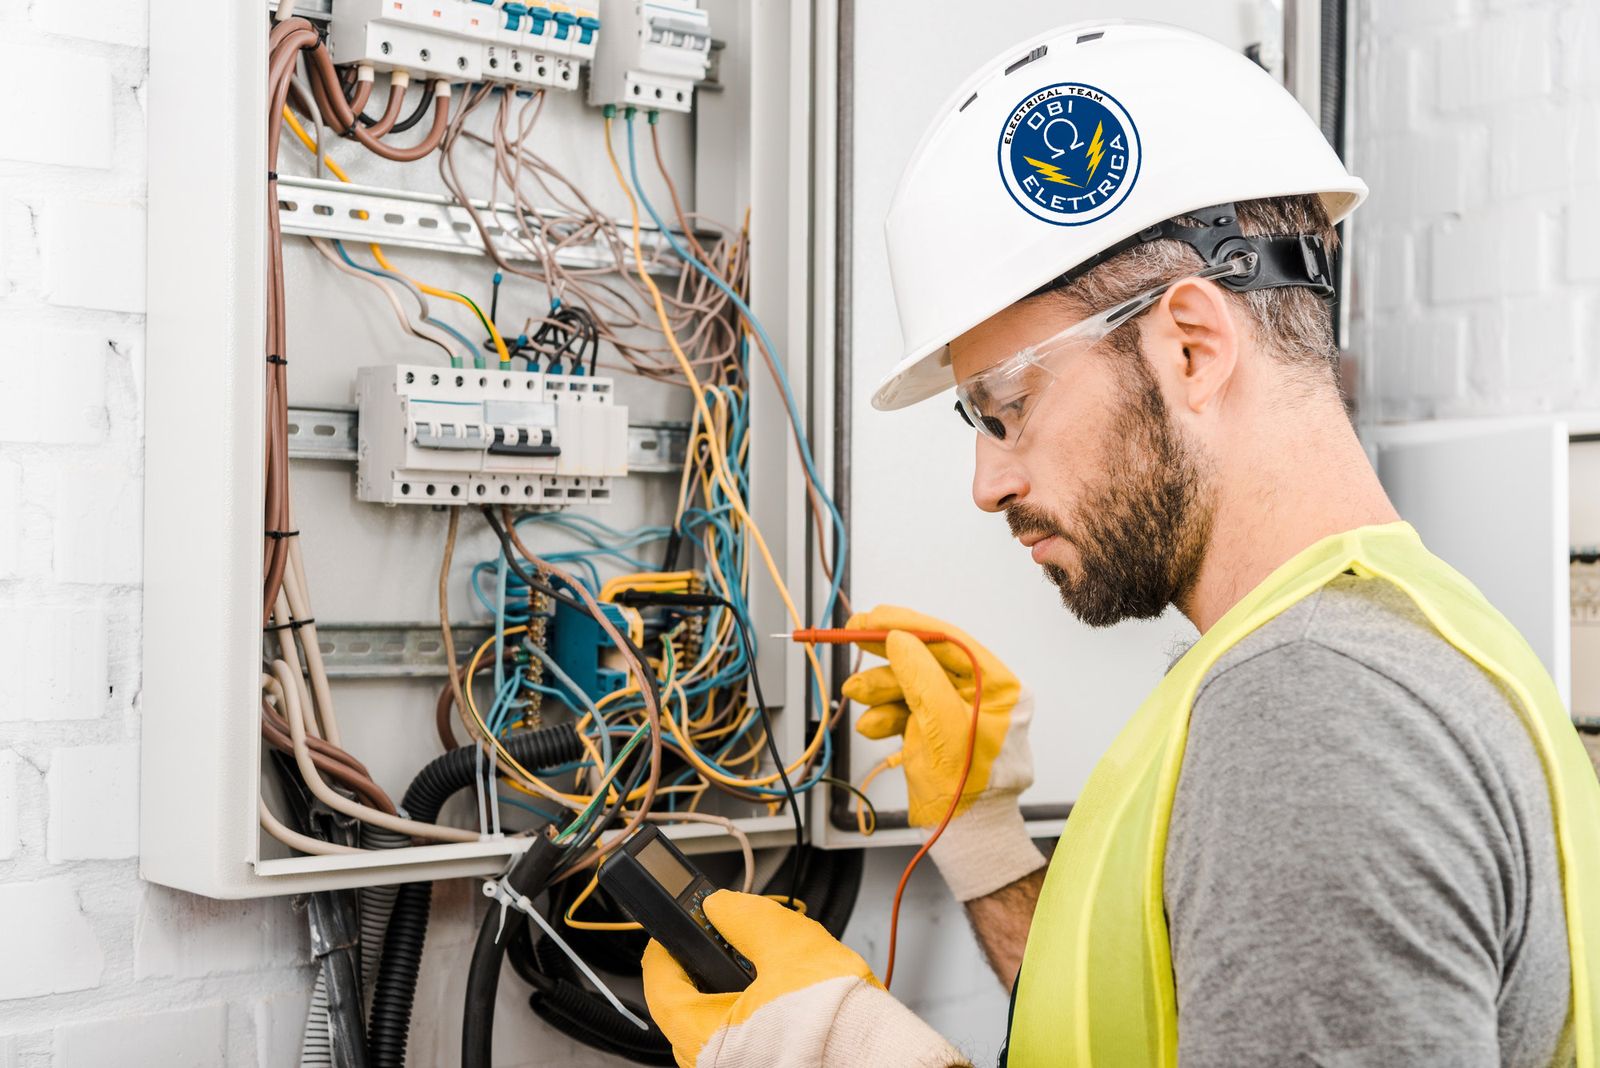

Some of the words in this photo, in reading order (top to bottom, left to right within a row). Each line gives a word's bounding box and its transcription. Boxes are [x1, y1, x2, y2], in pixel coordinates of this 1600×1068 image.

[1004, 88, 1062, 145] ELECTRICAL
[1068, 87, 1104, 103] TEAM
[1027, 100, 1073, 131] OBI
[1022, 134, 1125, 211] ELETTRICA
